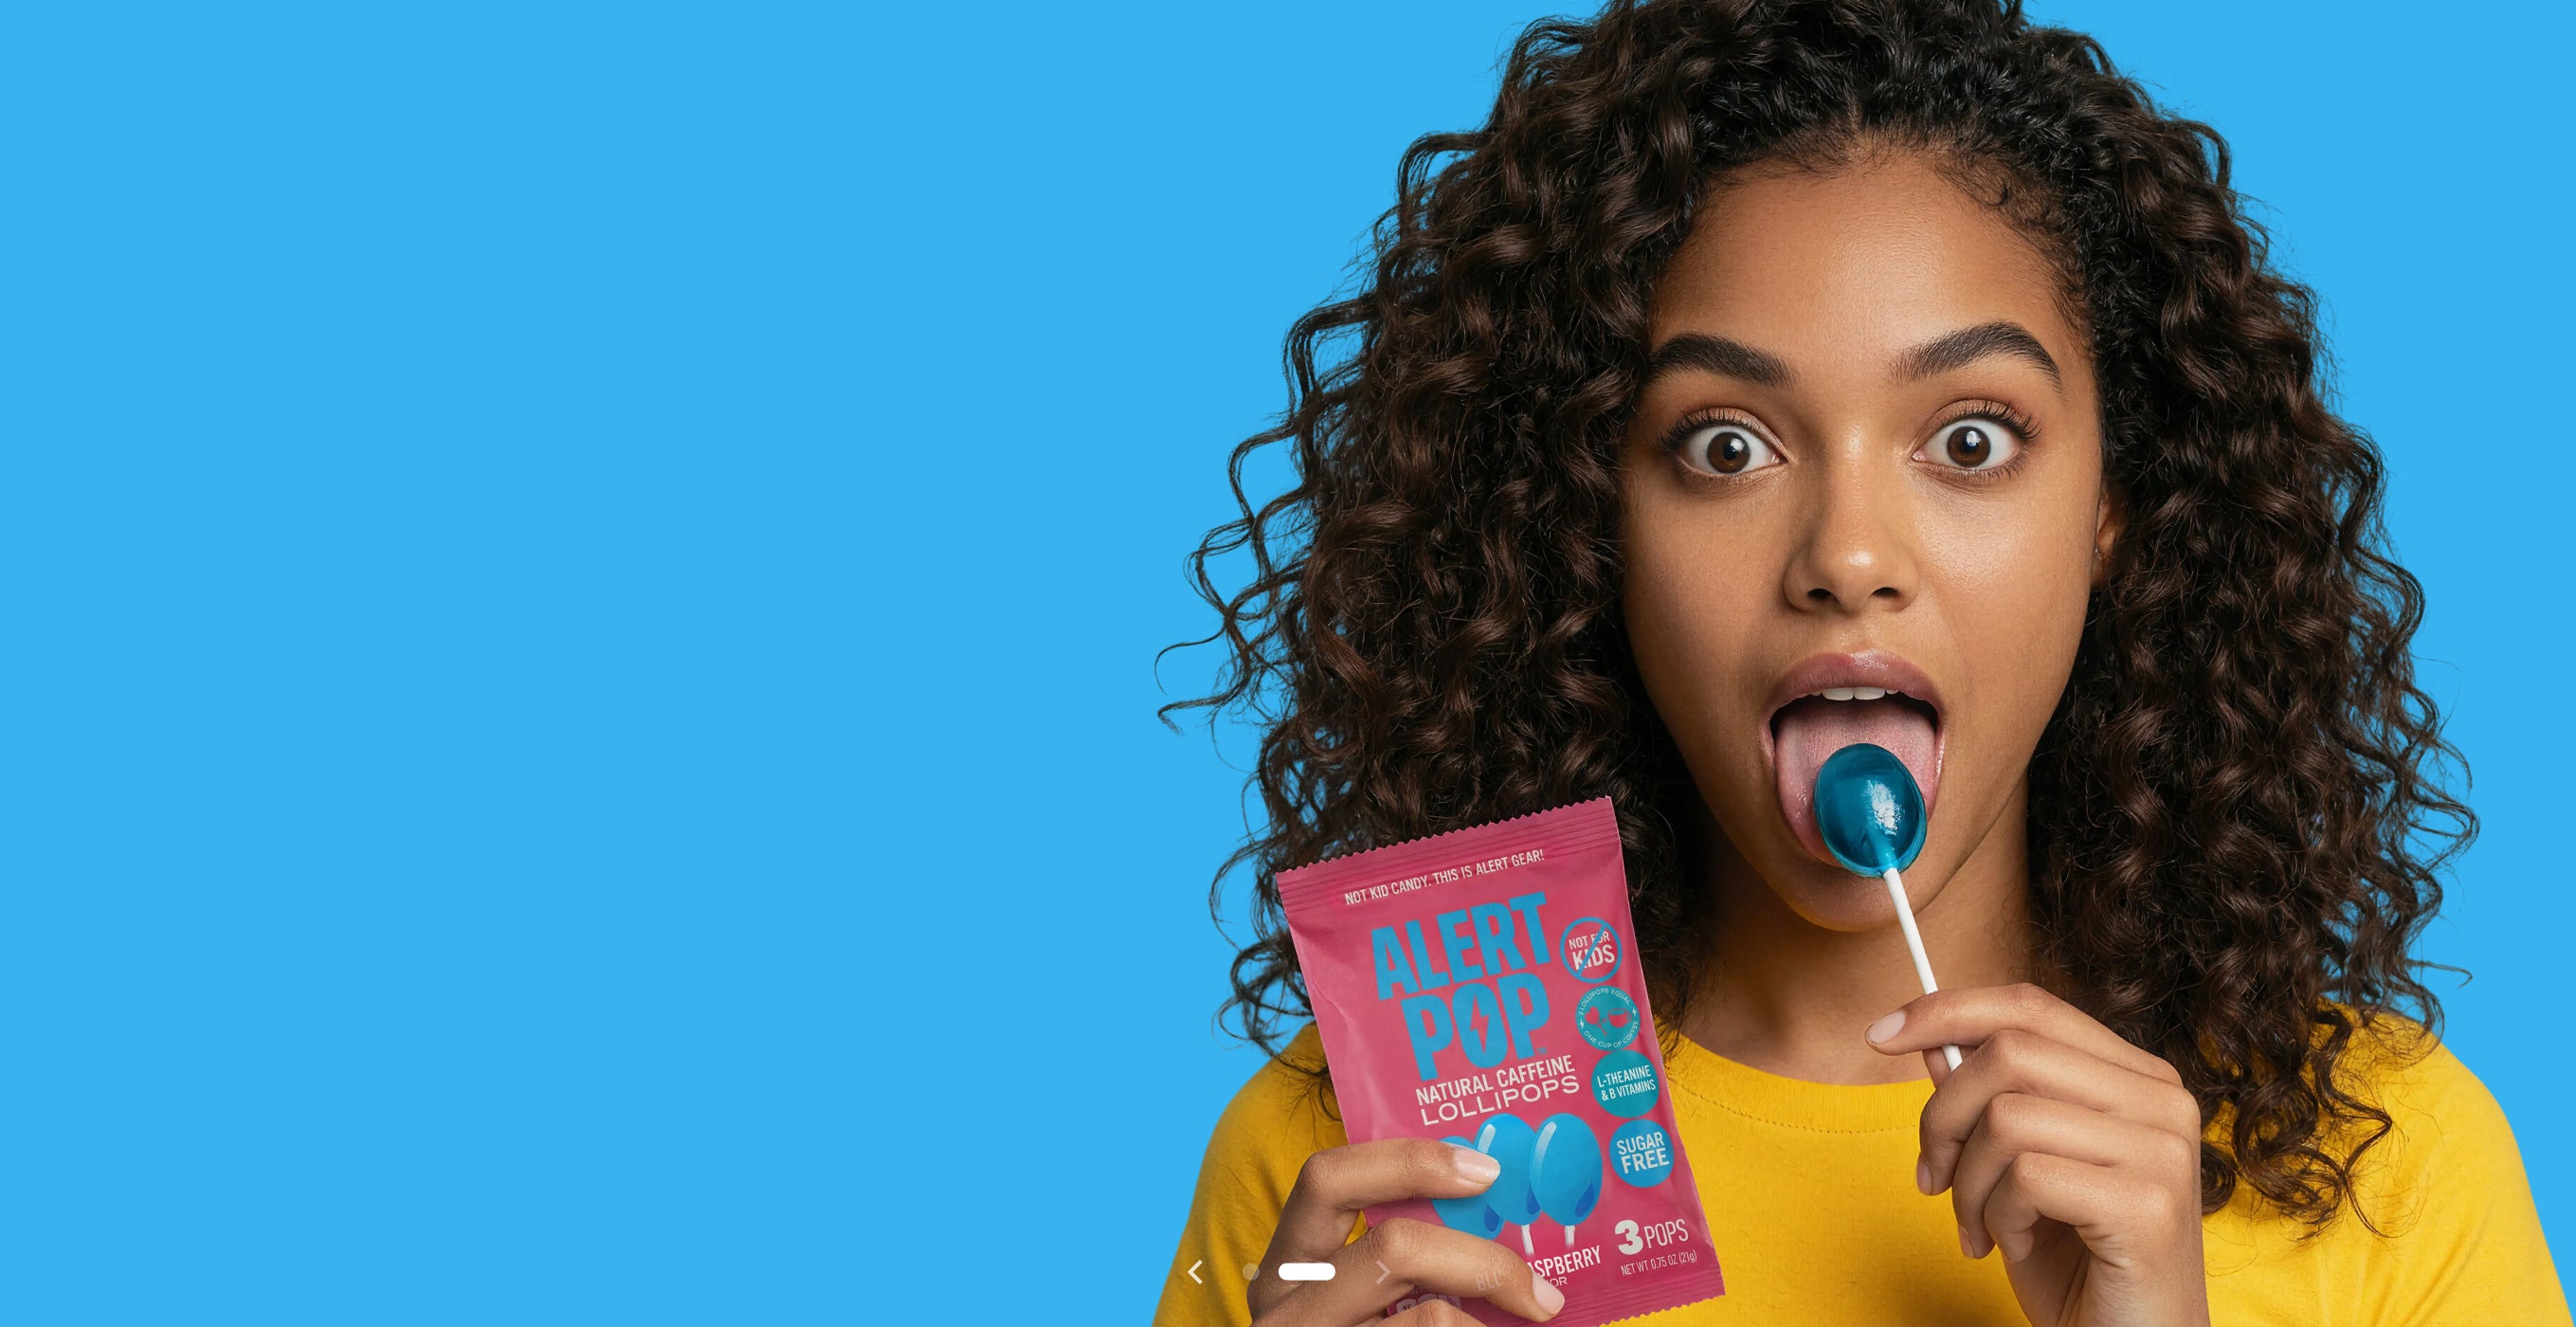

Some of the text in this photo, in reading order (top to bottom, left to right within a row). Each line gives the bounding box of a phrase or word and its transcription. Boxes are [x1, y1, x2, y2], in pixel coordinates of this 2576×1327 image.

[1345, 848, 1545, 905] NOT KID CANDY. THIS IS ALERT GEAR!
[1371, 891, 1551, 1001] ALERT
[1569, 931, 1610, 950] NOT FOR
[1571, 944, 1615, 971] KIDS
[1580, 988, 1609, 1009] LOLLIPOPS
[1611, 989, 1630, 1006] EQUAL
[1401, 973, 1551, 1082] POP
[1584, 1020, 1639, 1048] ONE CUP OF COFFEE
[1415, 1054, 1575, 1106] NATURAL CAFFEINE
[1597, 1064, 1651, 1087] L-THEANINE
[1421, 1075, 1580, 1126] LOLLIPOPS
[1601, 1079, 1657, 1101] & B VITAMINS
[1616, 1132, 1665, 1155] SUGAR
[1621, 1147, 1670, 1174] FREE
[1615, 1218, 1689, 1255] 3 POPS
[1621, 1249, 1697, 1276] NET WT 0.75 OZ (21g)
